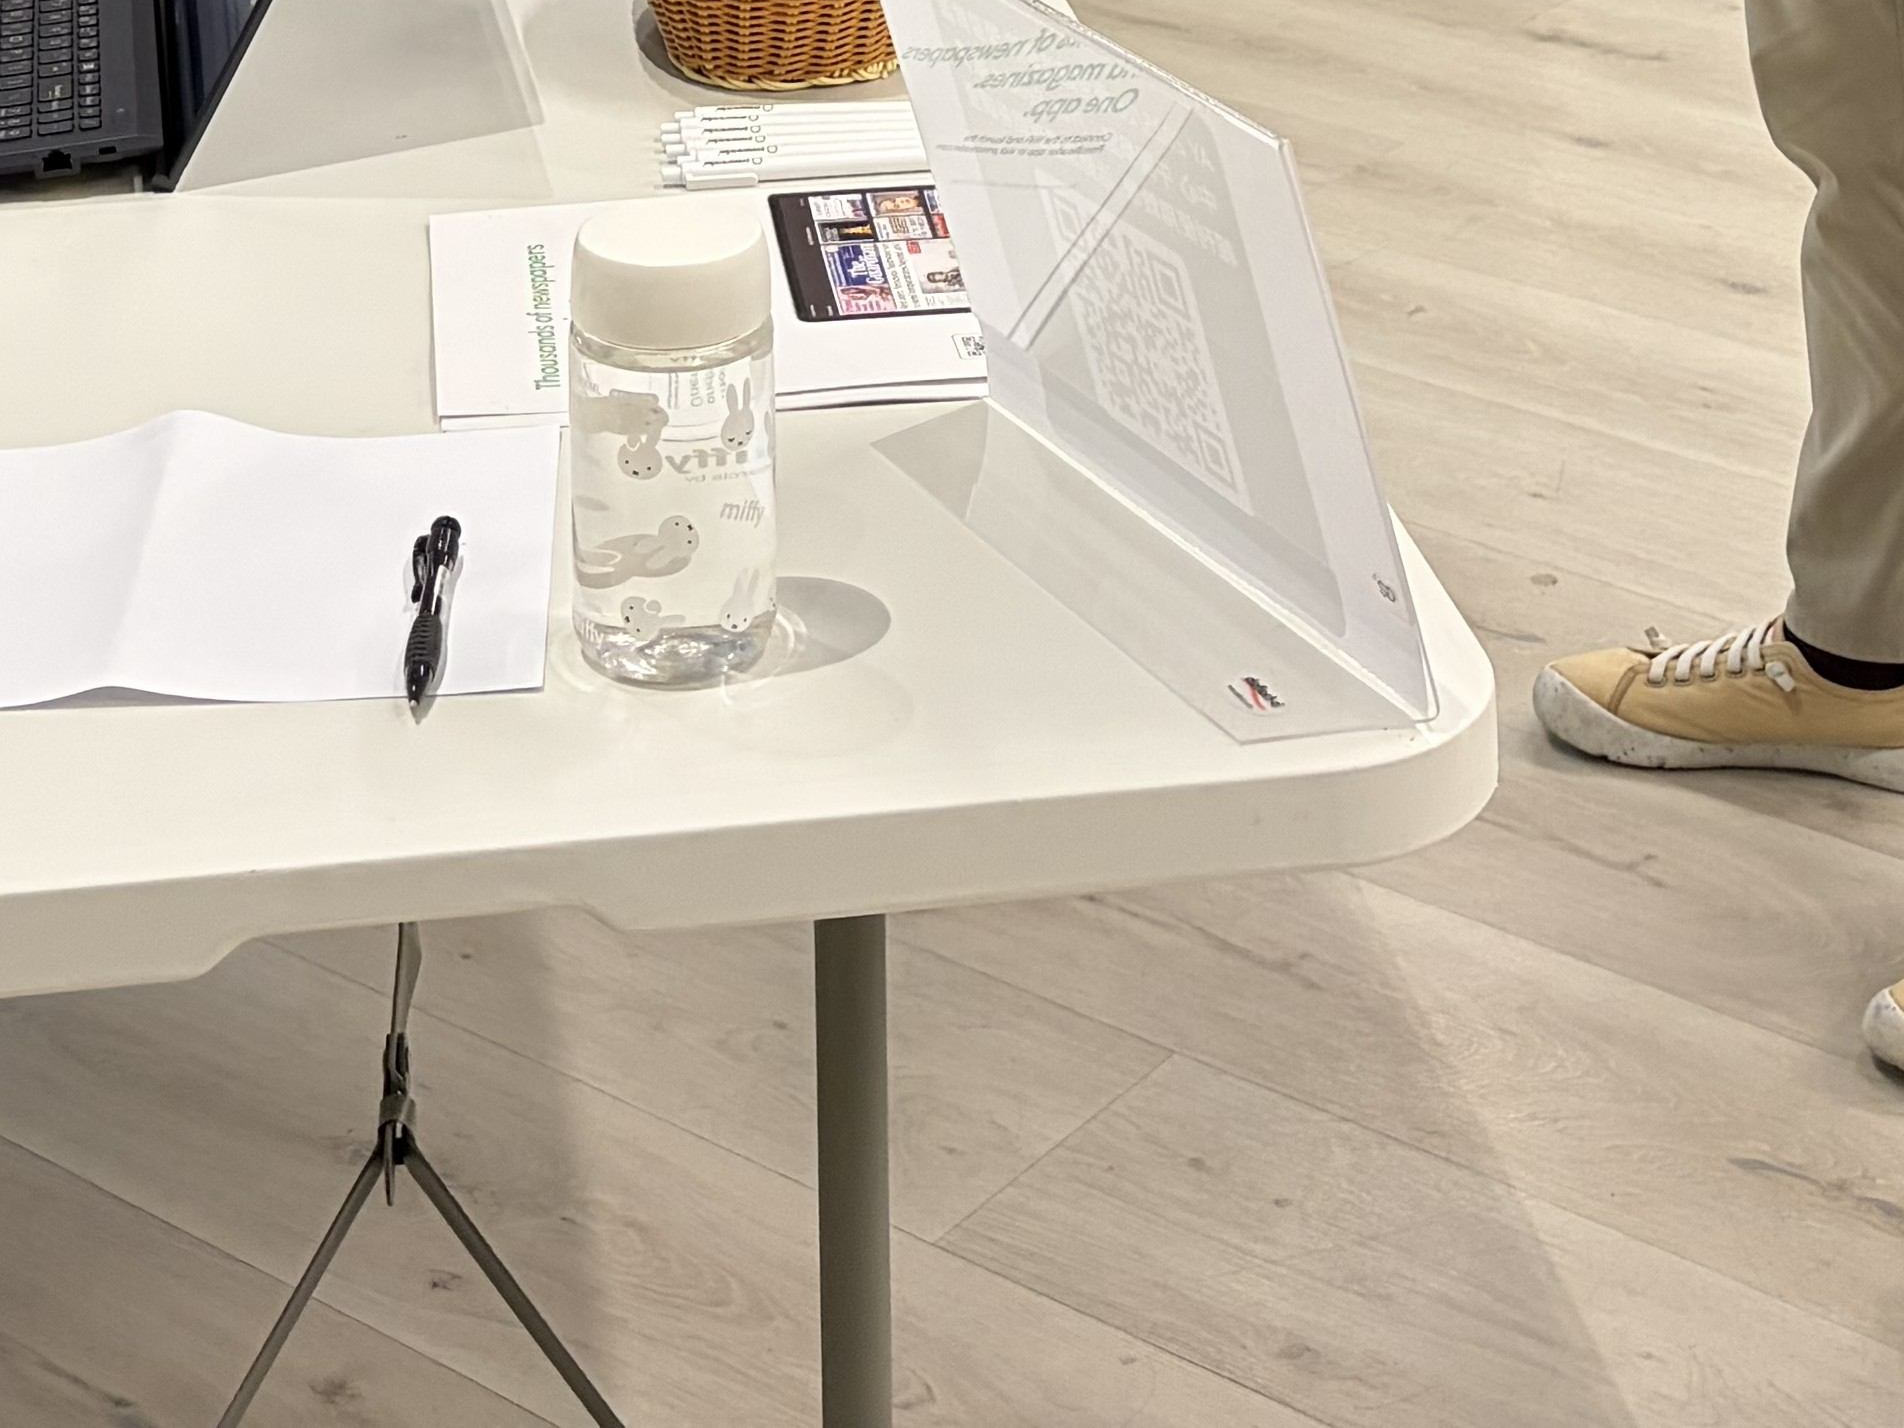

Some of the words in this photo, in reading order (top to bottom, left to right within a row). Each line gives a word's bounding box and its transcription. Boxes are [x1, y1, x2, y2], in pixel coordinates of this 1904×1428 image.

[527, 244, 556, 309] newspapers
[526, 312, 553, 323] of
[528, 325, 561, 391] Thousands
[720, 499, 765, 528] miffy
